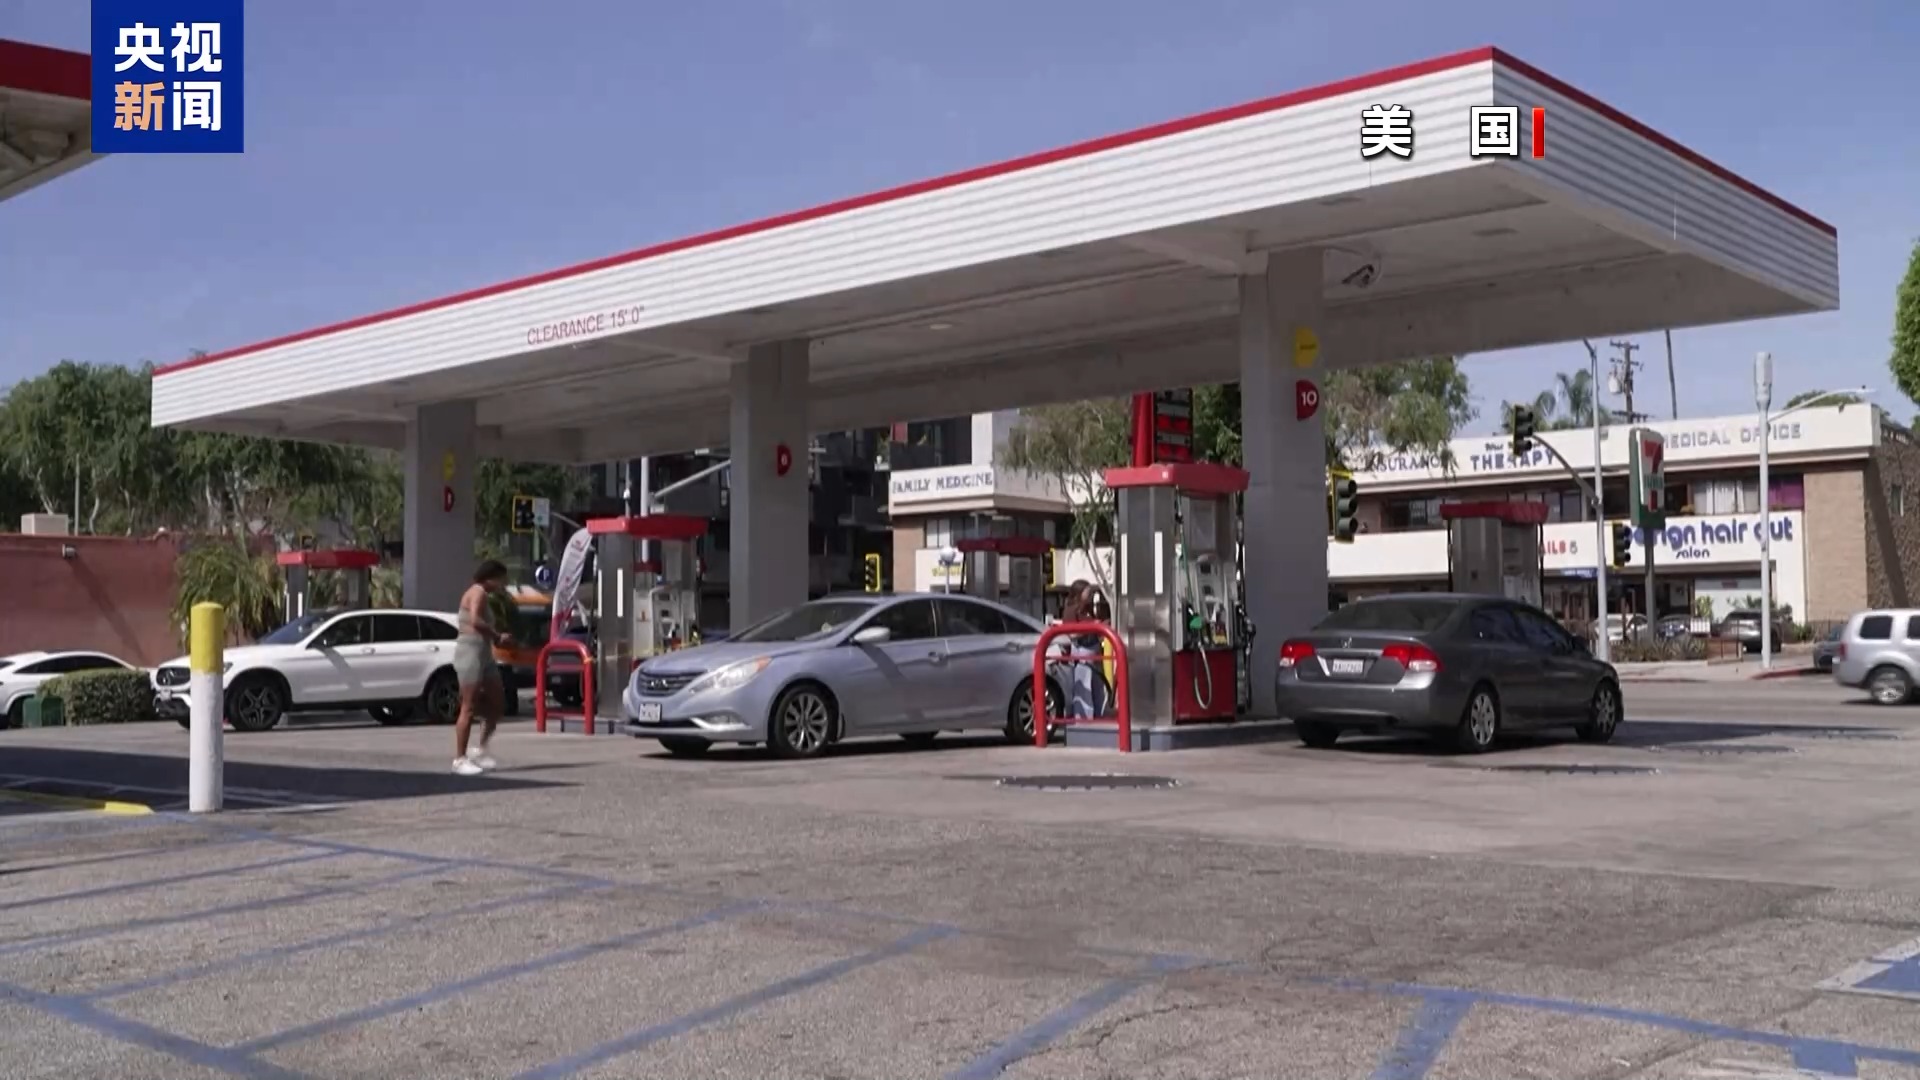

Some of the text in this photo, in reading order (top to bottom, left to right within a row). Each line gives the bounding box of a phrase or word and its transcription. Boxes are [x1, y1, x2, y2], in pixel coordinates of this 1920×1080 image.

[527, 313, 604, 345] CLEARANCE
[1301, 391, 1317, 406] 10
[1740, 422, 1801, 443] OFICE
[893, 472, 993, 493] FAMILY MEDICINE
[1701, 518, 1748, 544] hair
[1676, 546, 1710, 559] salon
